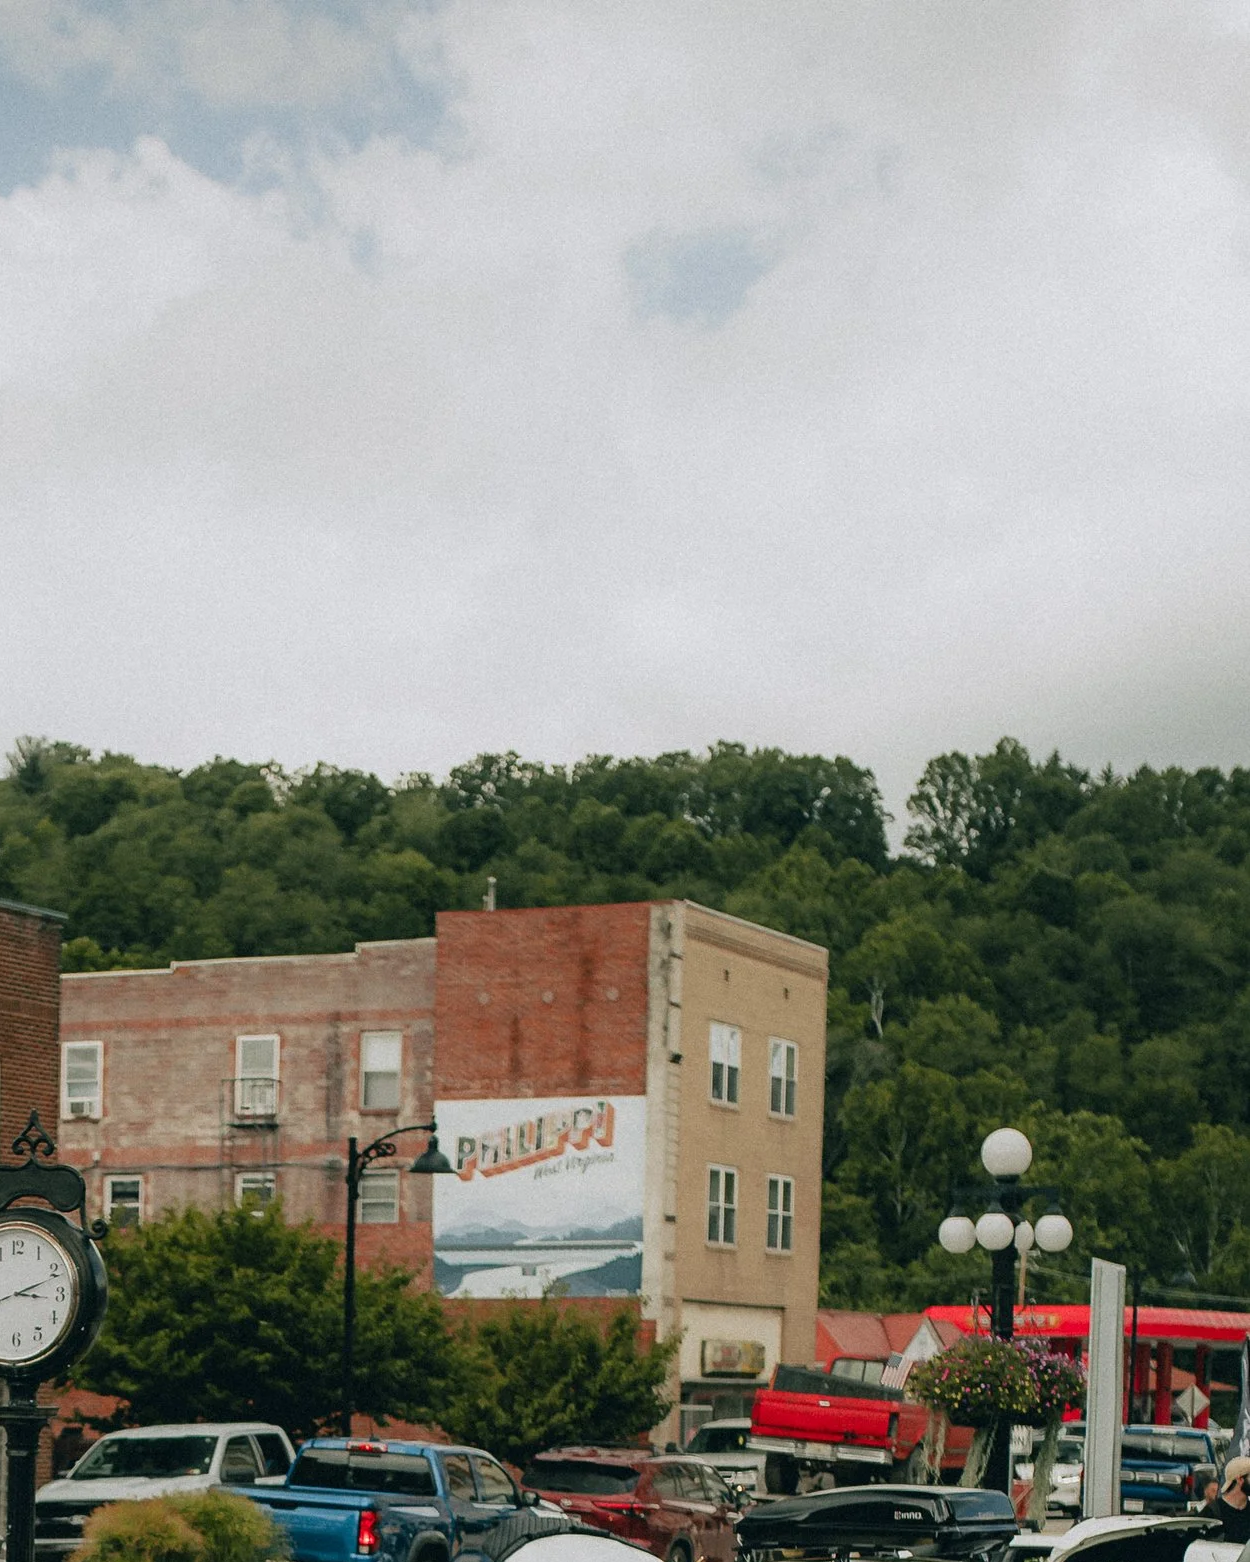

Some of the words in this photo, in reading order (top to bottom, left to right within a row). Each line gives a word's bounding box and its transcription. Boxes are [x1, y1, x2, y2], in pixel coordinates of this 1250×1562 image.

[456, 1101, 615, 1181] PHILIPPI
[565, 1152, 615, 1173] Virginia
[12, 1239, 25, 1256] 12
[36, 1245, 41, 1261] 1
[50, 1262, 60, 1278] 2
[55, 1286, 66, 1302] 3
[51, 1310, 59, 1325] 4
[11, 1331, 22, 1348] 6
[33, 1326, 43, 1341] 5
